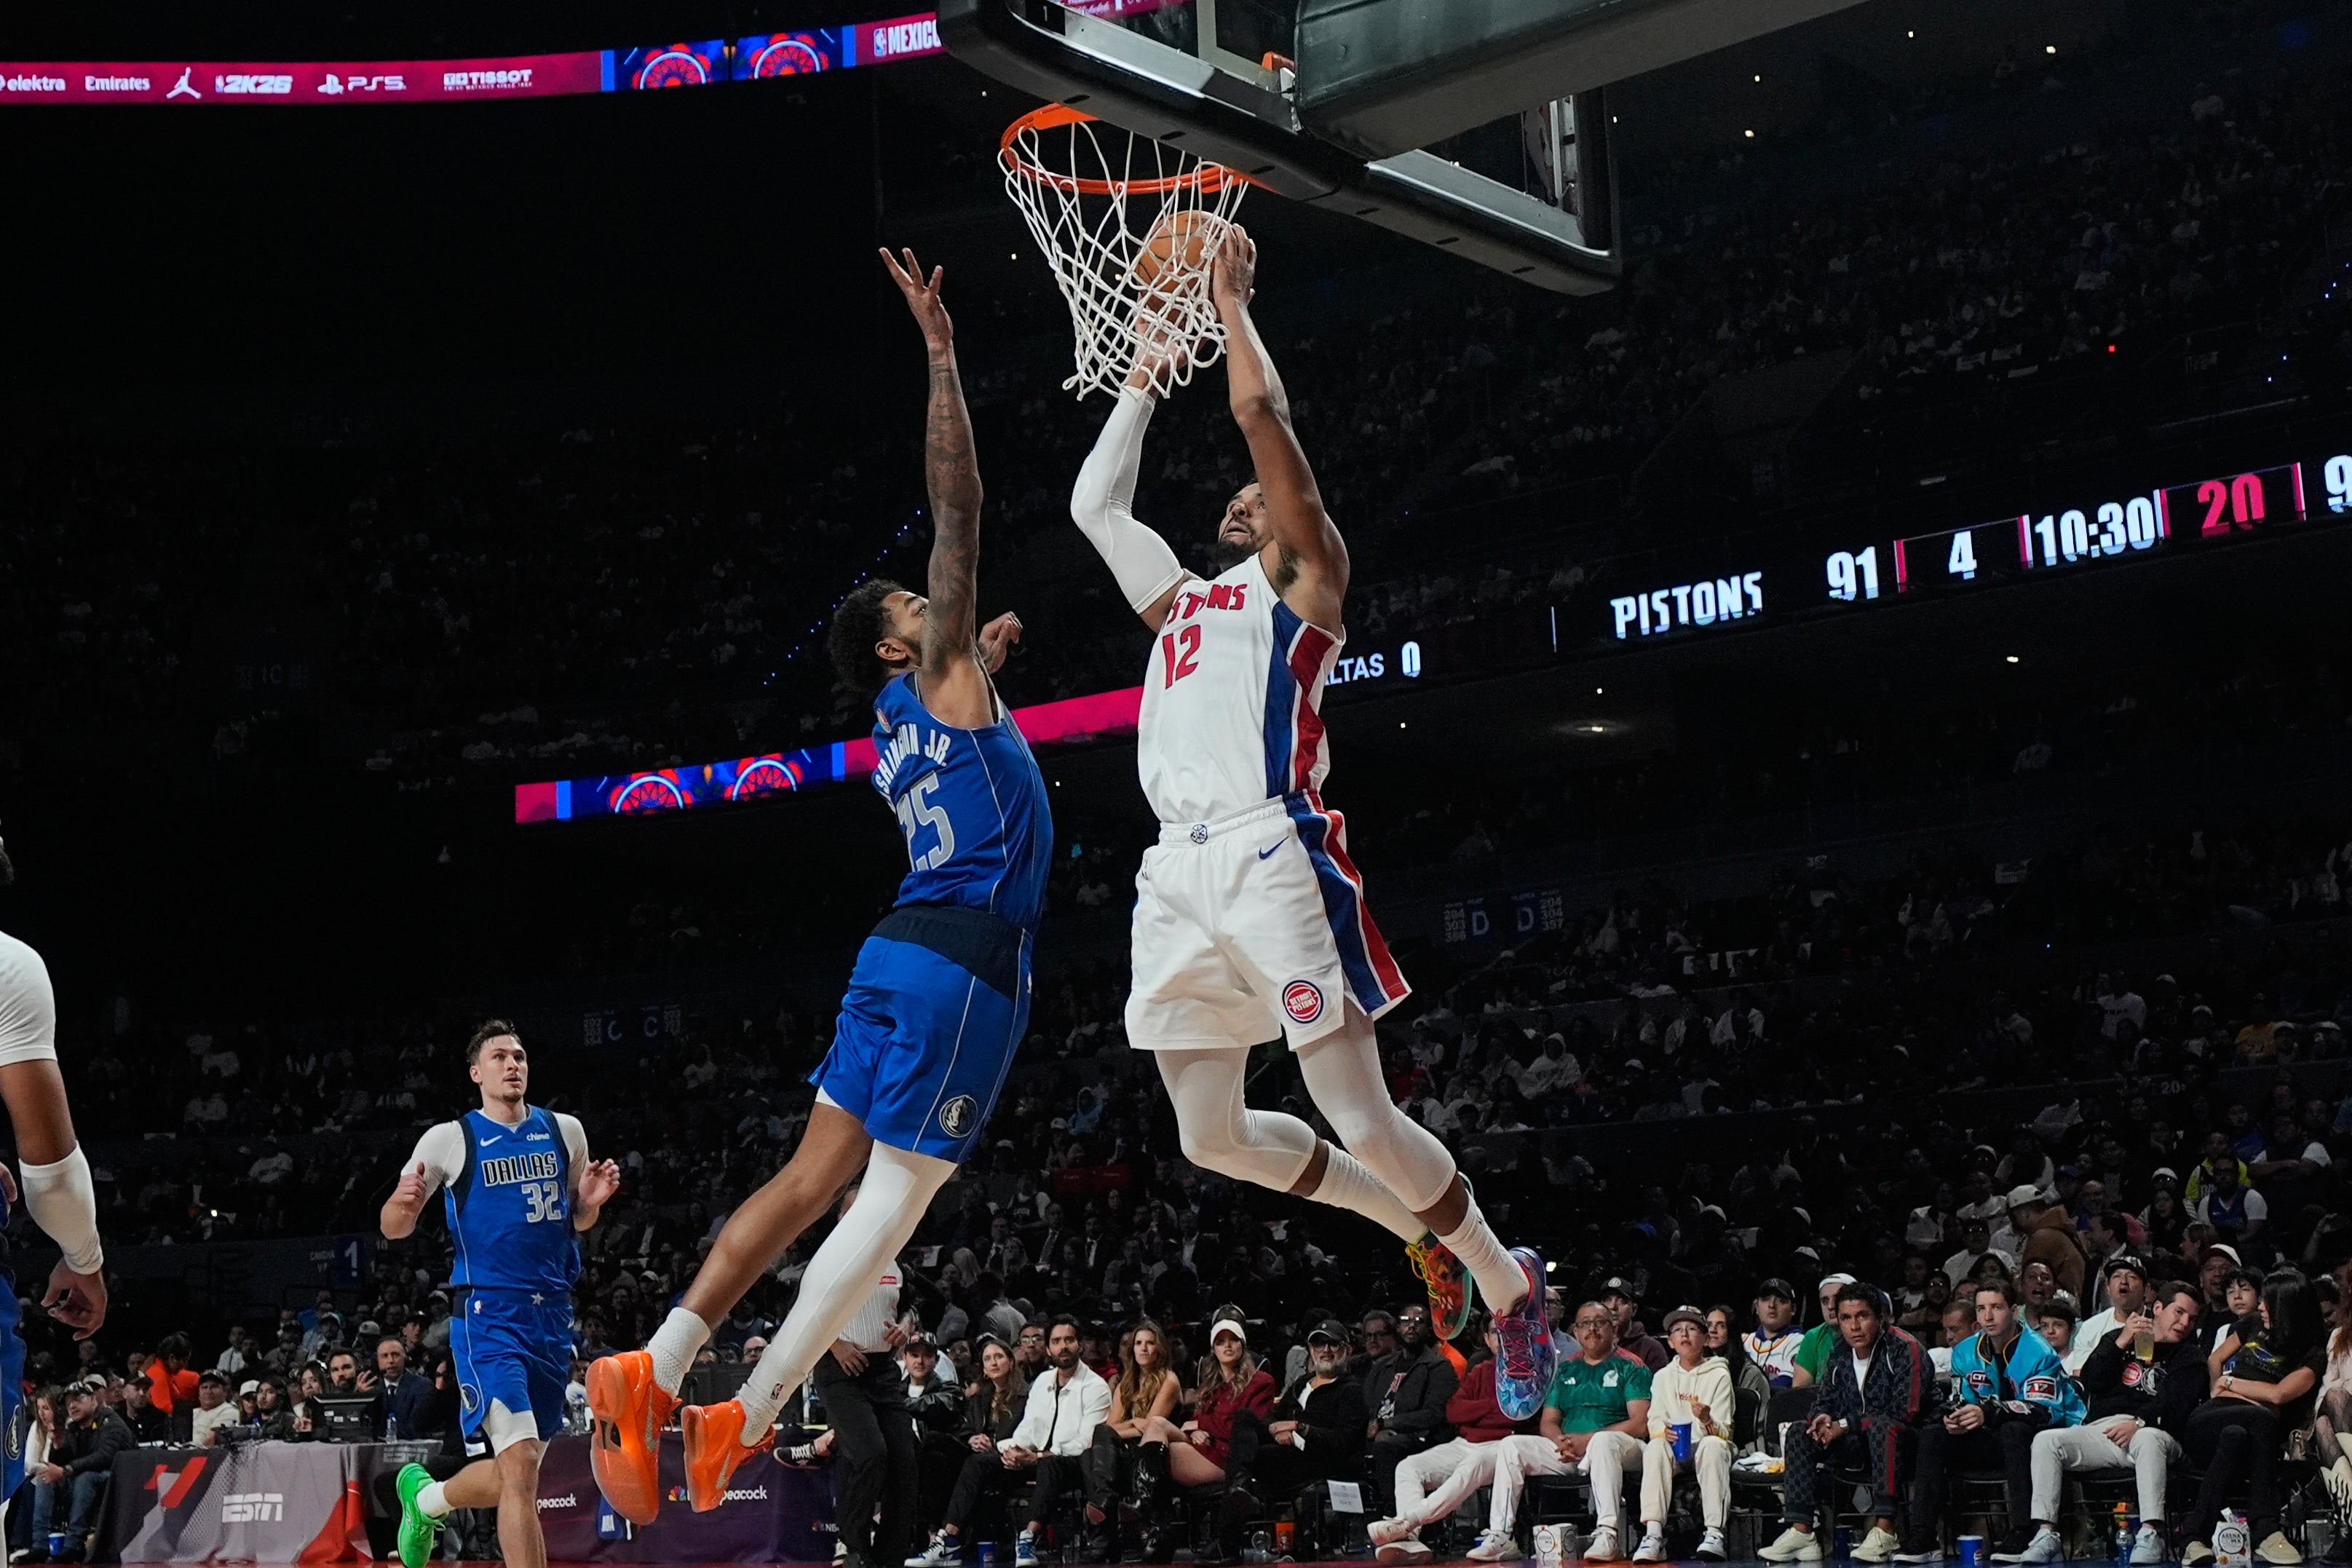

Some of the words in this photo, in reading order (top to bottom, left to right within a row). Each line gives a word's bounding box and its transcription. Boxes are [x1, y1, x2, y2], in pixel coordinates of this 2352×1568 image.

[7, 74, 66, 91] elektra
[85, 75, 151, 91] Emirates
[223, 75, 293, 94] 2K26
[348, 75, 403, 92] PS5
[470, 69, 532, 86] TISSOT
[2197, 474, 2265, 537] 20
[2035, 496, 2155, 566] 10:30
[1948, 530, 1978, 580] 4
[1609, 571, 1762, 639] PISTONS
[1826, 545, 1879, 601] 91
[1162, 624, 1201, 690] 12
[1325, 653, 1385, 686] LTAS
[1401, 641, 1421, 678] 0
[924, 729, 951, 767] JR.
[896, 769, 955, 872] 25
[1471, 910, 1490, 937] D
[1517, 906, 1535, 932] D
[607, 1020, 623, 1042] C
[644, 1015, 657, 1038] C
[526, 1133, 550, 1141] chime
[480, 1151, 558, 1187] DALLAS
[521, 1180, 562, 1223] 32
[383, 1446, 429, 1464] ESPN
[221, 1492, 284, 1524] ESPN
[536, 1493, 577, 1514] peacock
